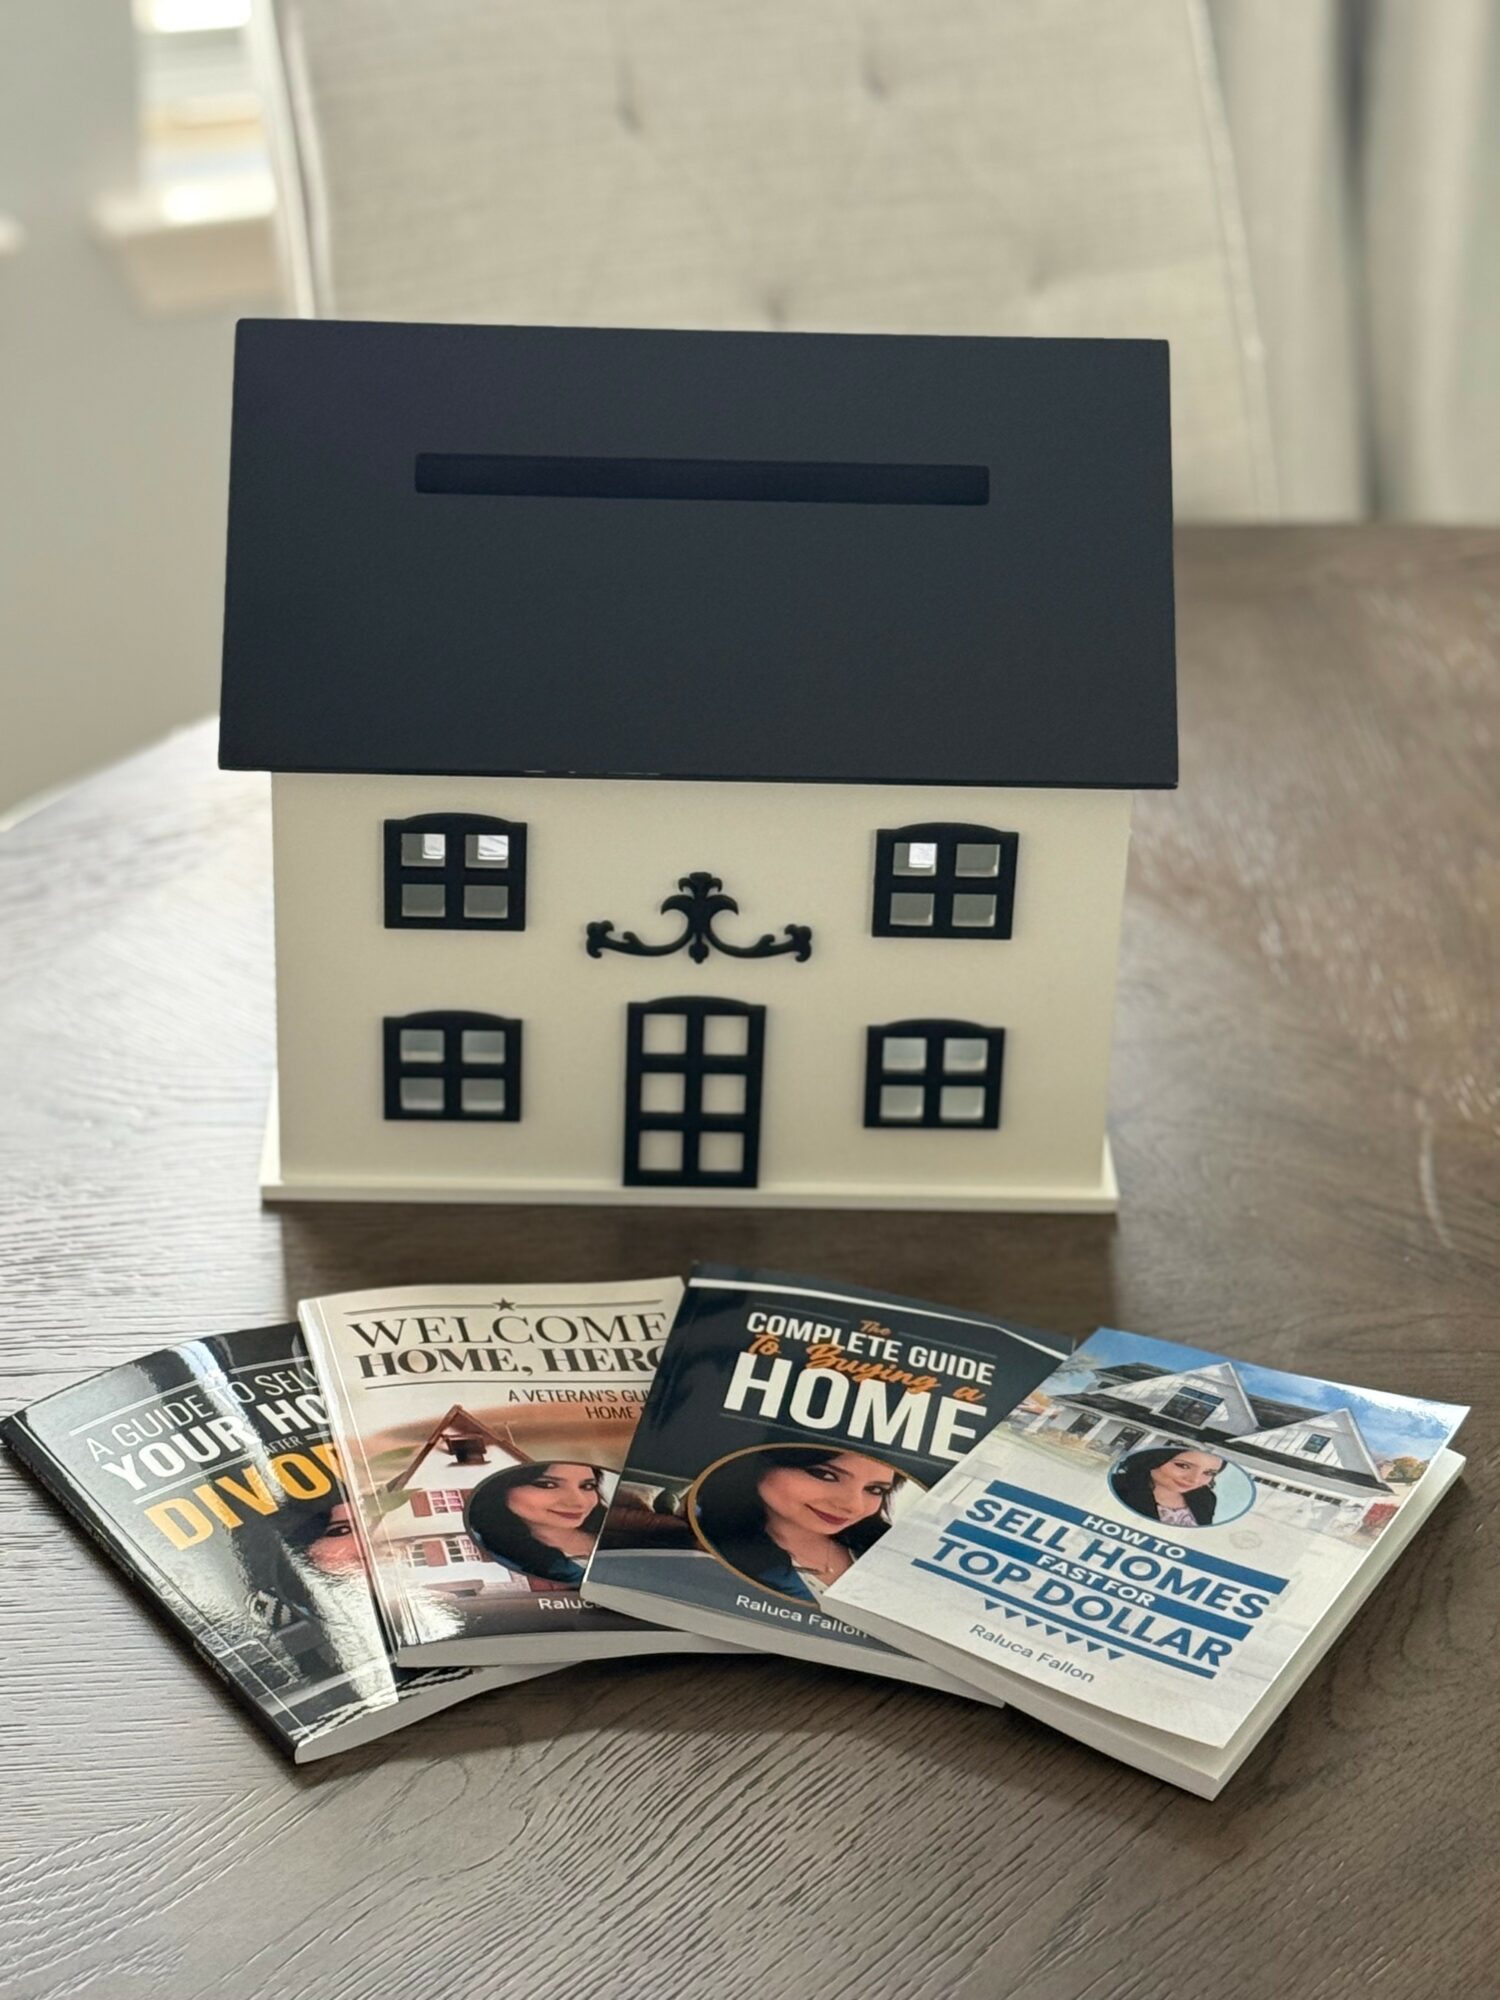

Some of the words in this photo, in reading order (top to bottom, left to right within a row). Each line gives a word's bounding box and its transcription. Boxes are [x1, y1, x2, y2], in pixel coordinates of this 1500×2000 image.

[347, 1312, 667, 1349] WELCOME
[746, 1311, 903, 1363] COMPLETE
[907, 1345, 996, 1386] GUIDE
[859, 1319, 892, 1337] The
[355, 1348, 534, 1379] HOME,
[805, 1343, 942, 1395] Buying
[953, 1386, 986, 1403] a
[86, 1437, 114, 1462] A
[111, 1395, 214, 1446] GUIDE
[204, 1381, 256, 1409] TO
[508, 1389, 520, 1403] A
[522, 1389, 619, 1403] VETERAN'S
[585, 1406, 637, 1420] HOME
[722, 1350, 989, 1463] HOME
[102, 1415, 262, 1492] YOUR
[263, 1435, 304, 1456] AFTER
[966, 1498, 1070, 1553] SELL
[1078, 1537, 1271, 1620] HOMES
[1082, 1515, 1146, 1547] HOW
[1150, 1538, 1187, 1560] TO
[932, 1536, 1032, 1585] TOP
[1032, 1577, 1234, 1668] DOLLAR
[1036, 1553, 1103, 1587] FAST
[1100, 1579, 1156, 1607] FOR
[736, 1594, 802, 1623] Raluca
[807, 1612, 870, 1639] Fallon
[969, 1623, 1034, 1659] Raluca
[1035, 1653, 1096, 1684] Fallon
